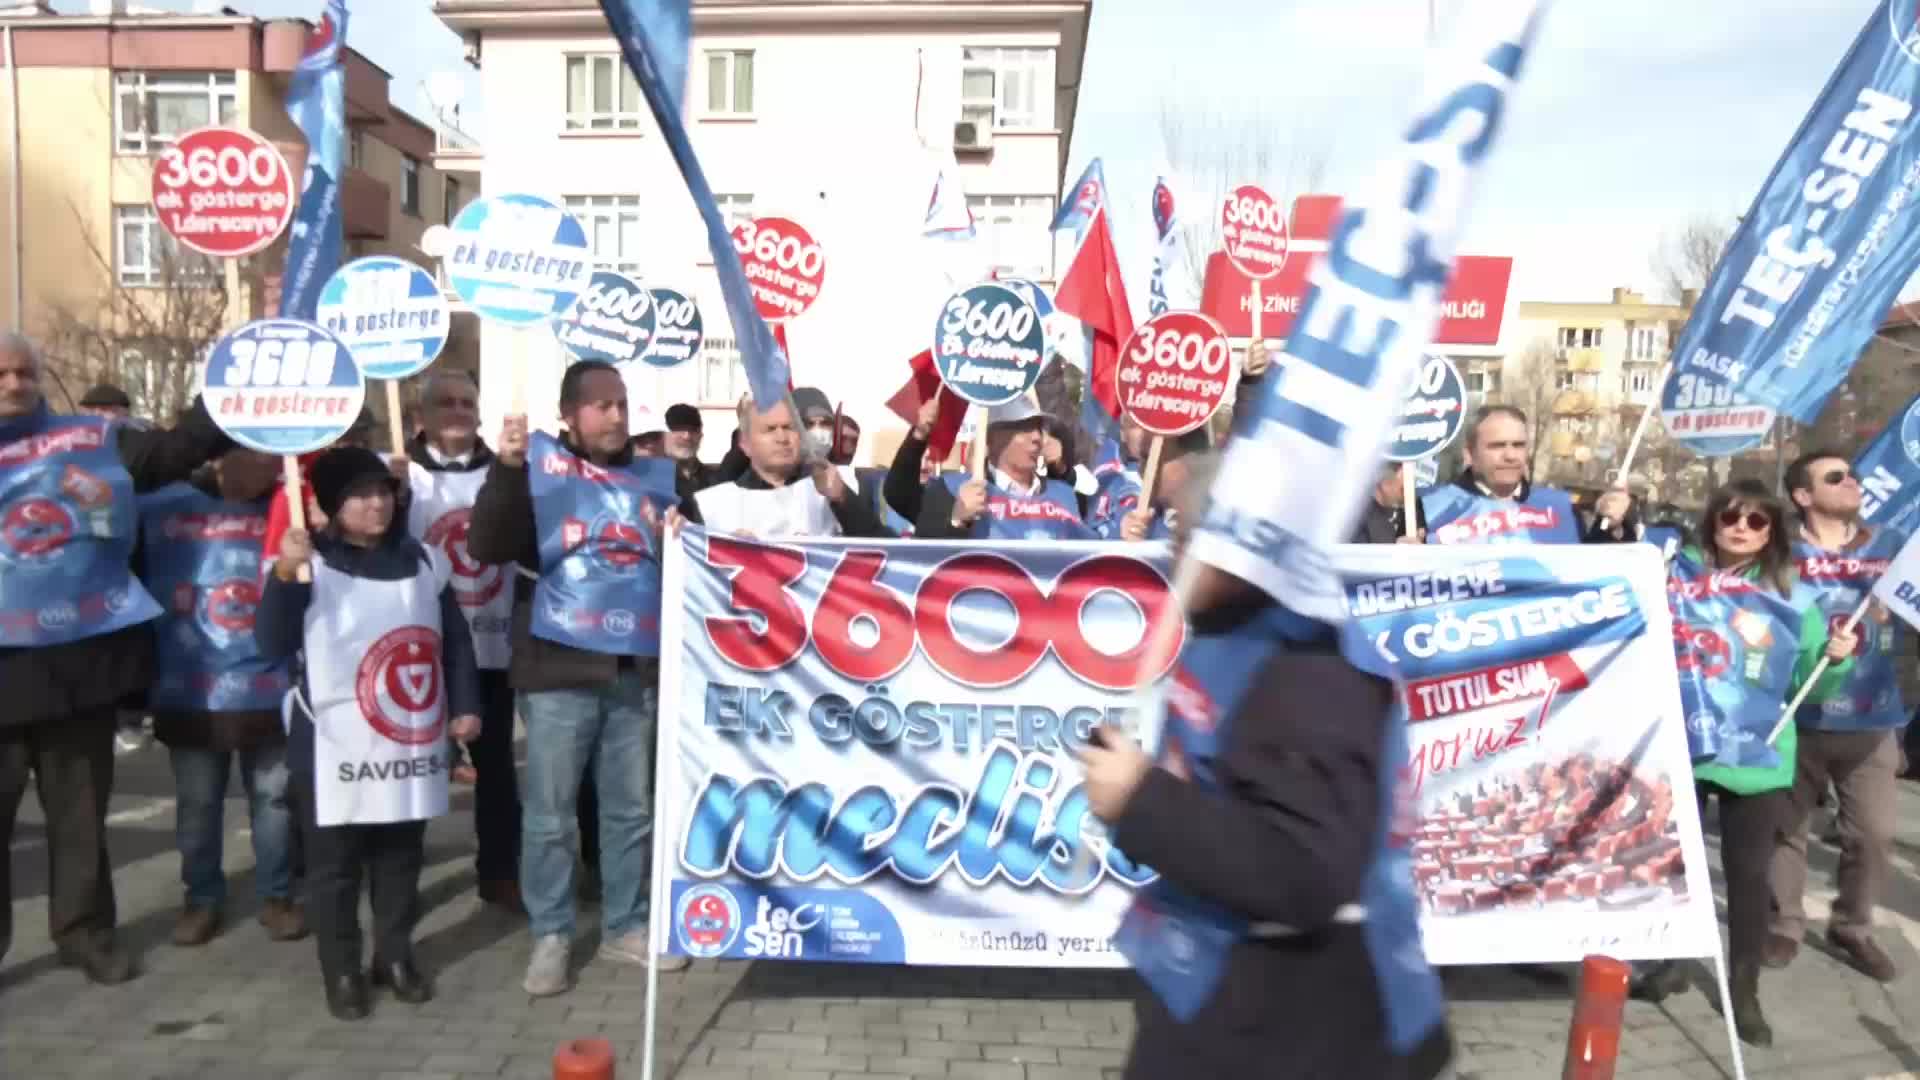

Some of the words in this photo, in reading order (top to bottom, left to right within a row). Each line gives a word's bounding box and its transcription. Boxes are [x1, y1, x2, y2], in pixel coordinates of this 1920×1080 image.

[159, 146, 279, 188] 3600
[156, 190, 184, 209] ek
[189, 190, 287, 213] gösterge
[1223, 192, 1283, 233] 3600
[1721, 87, 1913, 328] TEÇ-SEN
[452, 240, 479, 265] ek
[730, 220, 824, 279] 3600
[580, 281, 651, 322] 600
[942, 296, 1036, 343] 3600
[1438, 298, 1487, 320] NLIĞI
[224, 339, 338, 386] 3600
[1130, 326, 1228, 375] 3600
[1119, 366, 1142, 384] ek
[1145, 371, 1225, 398] gösterge
[703, 535, 1186, 692] 3600
[1402, 583, 1632, 660] GÖSTERGE
[704, 681, 795, 742] EK
